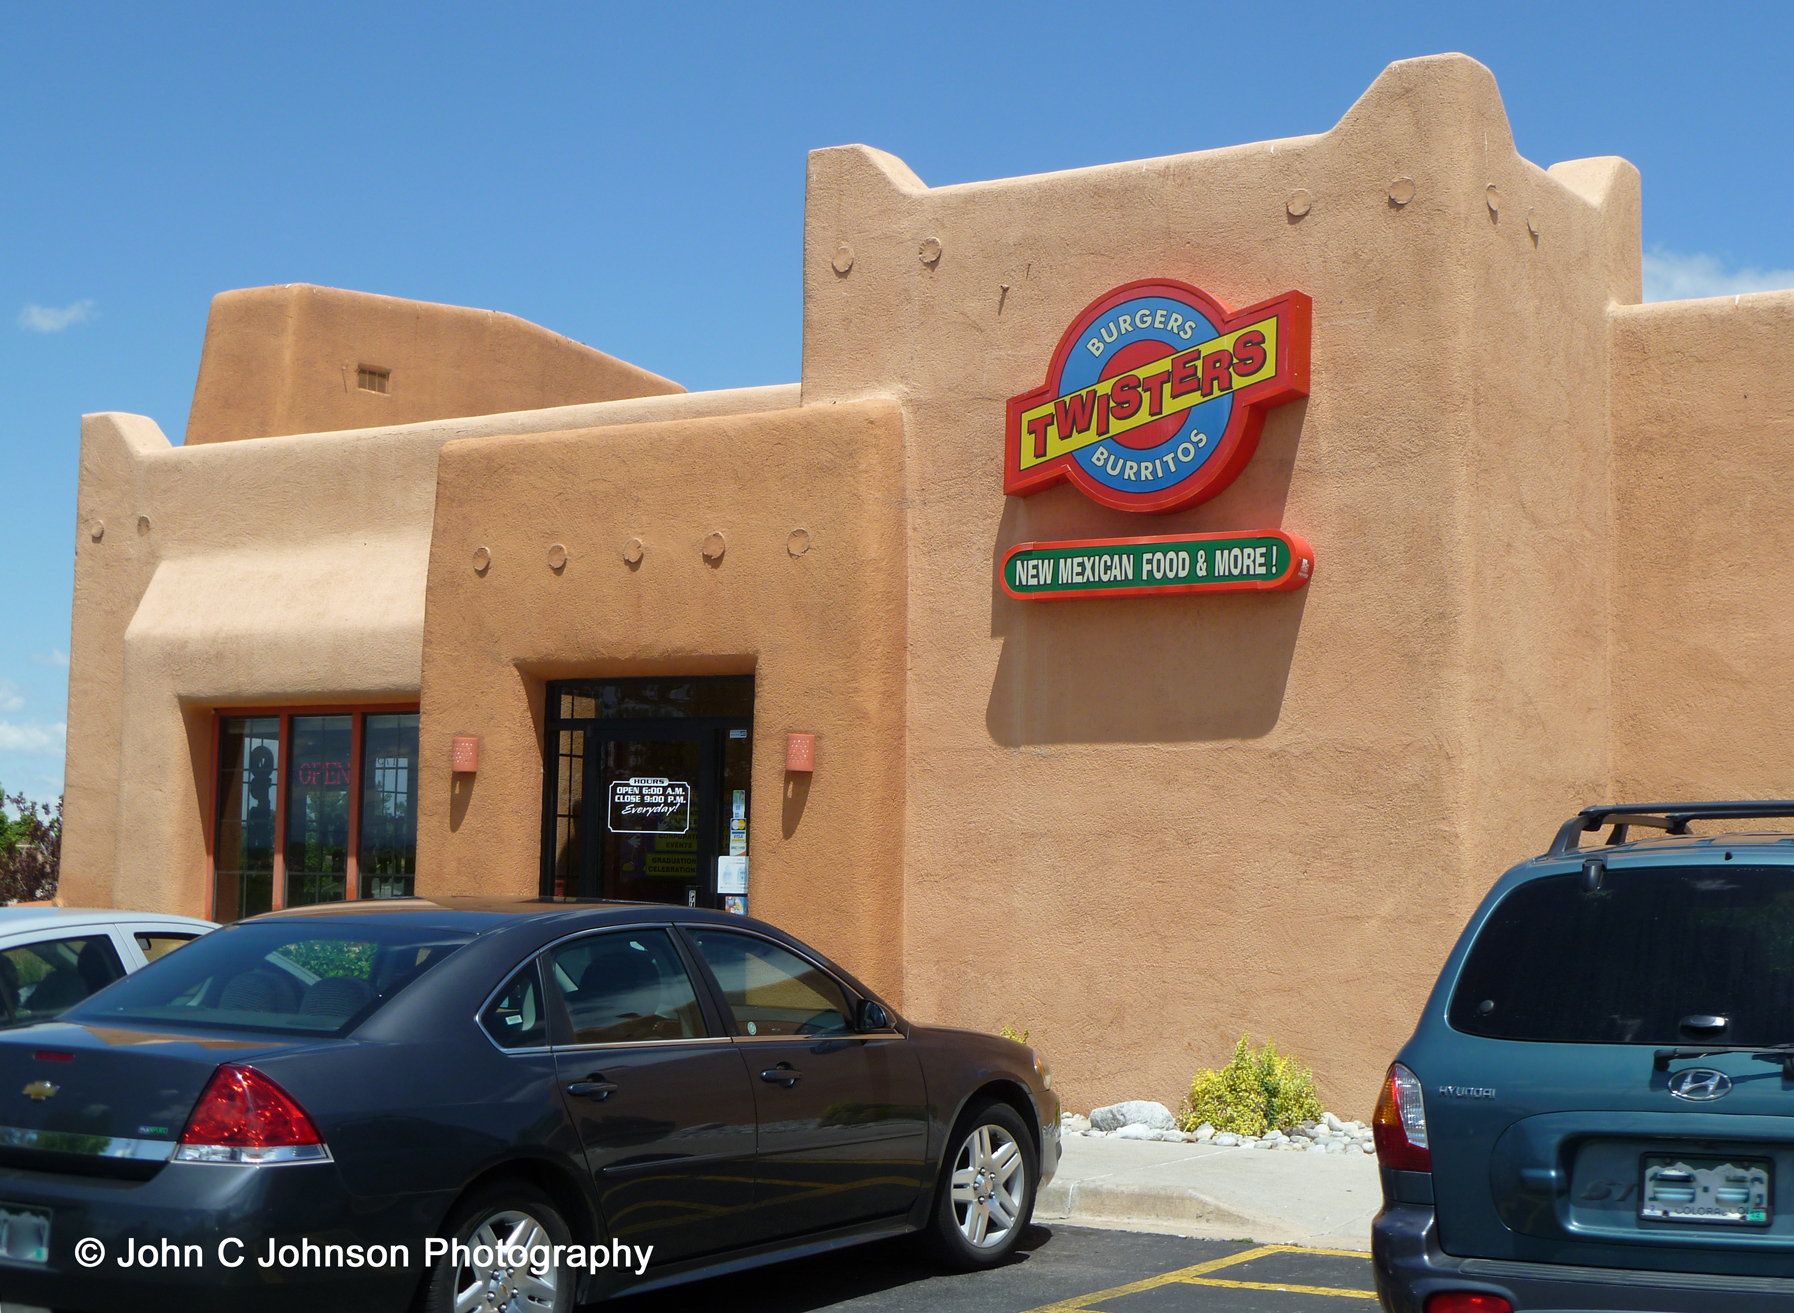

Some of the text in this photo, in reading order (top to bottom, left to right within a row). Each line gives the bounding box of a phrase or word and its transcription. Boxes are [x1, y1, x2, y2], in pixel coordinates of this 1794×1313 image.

[1086, 308, 1197, 358] BURGERS
[1026, 329, 1268, 459] TWISTERS
[1090, 427, 1208, 482] BURRITOS
[1014, 558, 1054, 586] NEW
[1058, 554, 1134, 584] MEXICAN
[1142, 551, 1190, 581] FOOD
[1196, 549, 1207, 577] &
[299, 762, 351, 785] OPEN
[614, 795, 641, 803] CLOSE
[643, 795, 665, 803] 9:00
[667, 796, 687, 804] P.M.
[616, 786, 686, 795] OPEN 6:00 A.M.
[621, 803, 681, 817] Everyday!
[1438, 1085, 1496, 1099] HYUNDAI
